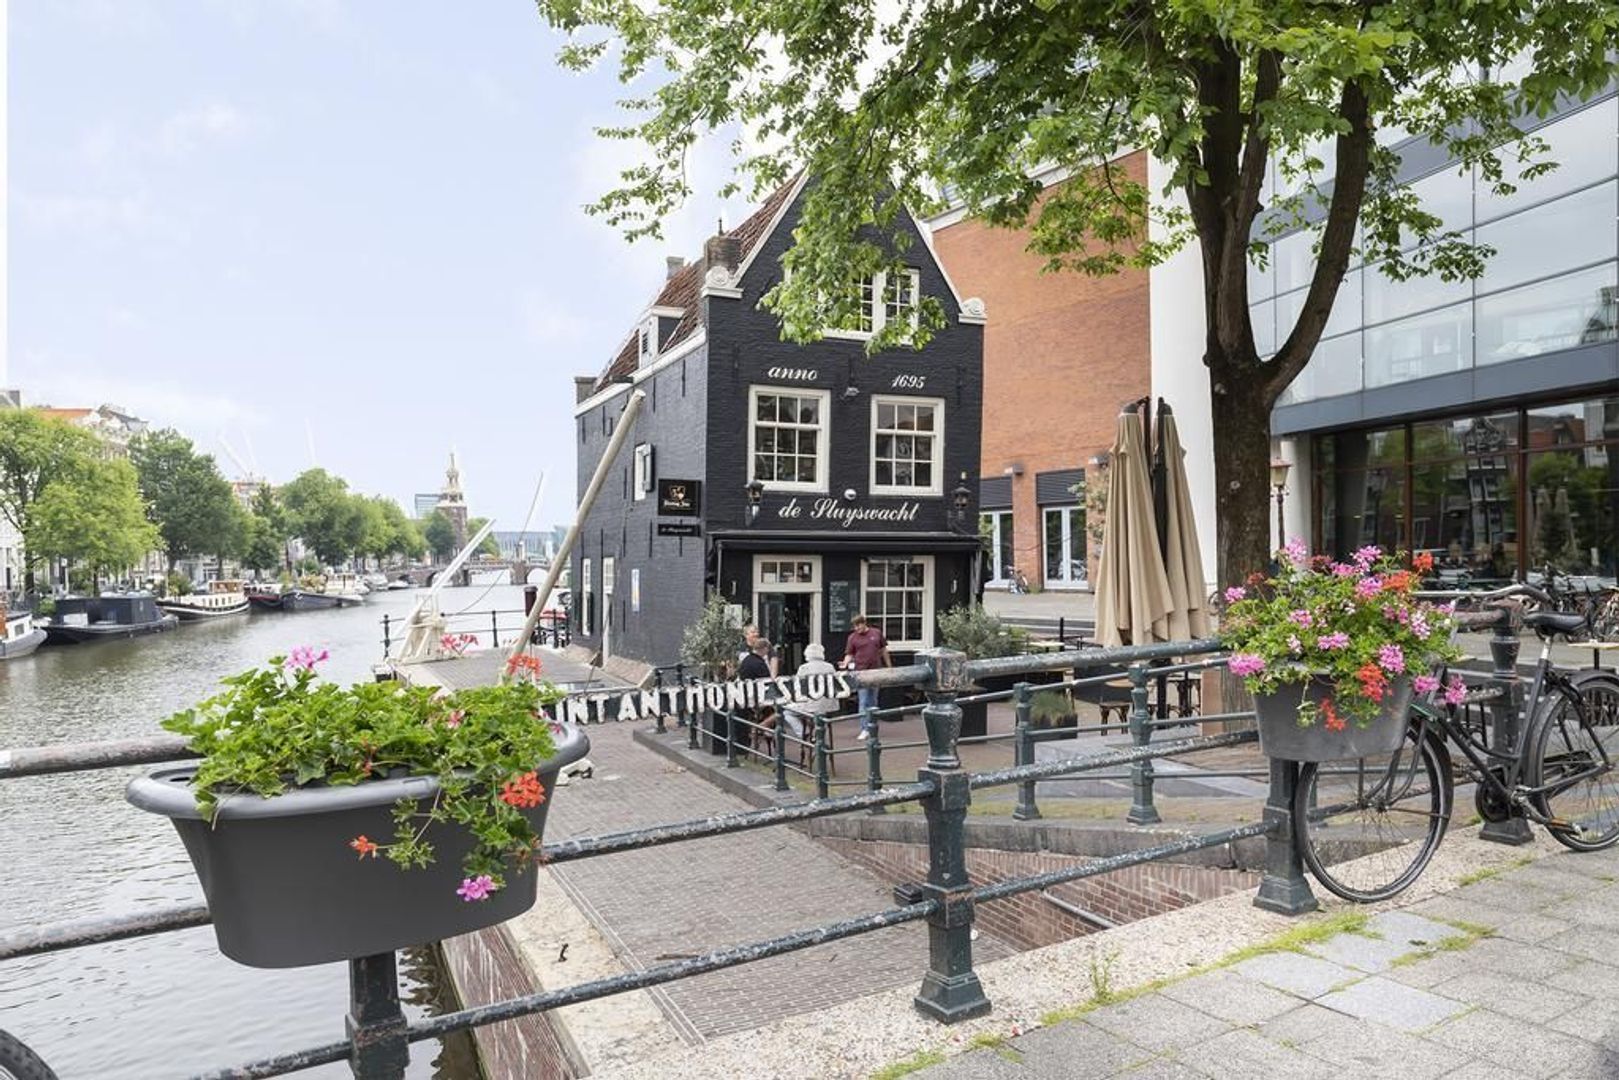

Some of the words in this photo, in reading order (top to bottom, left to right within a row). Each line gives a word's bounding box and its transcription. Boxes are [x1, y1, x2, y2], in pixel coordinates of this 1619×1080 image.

[768, 366, 818, 381] anno
[891, 374, 926, 389] 1695
[778, 498, 801, 518] de
[809, 498, 920, 527] Sluyswacht
[538, 692, 610, 724] INT
[616, 671, 851, 722] ANTHONIESLUIS
